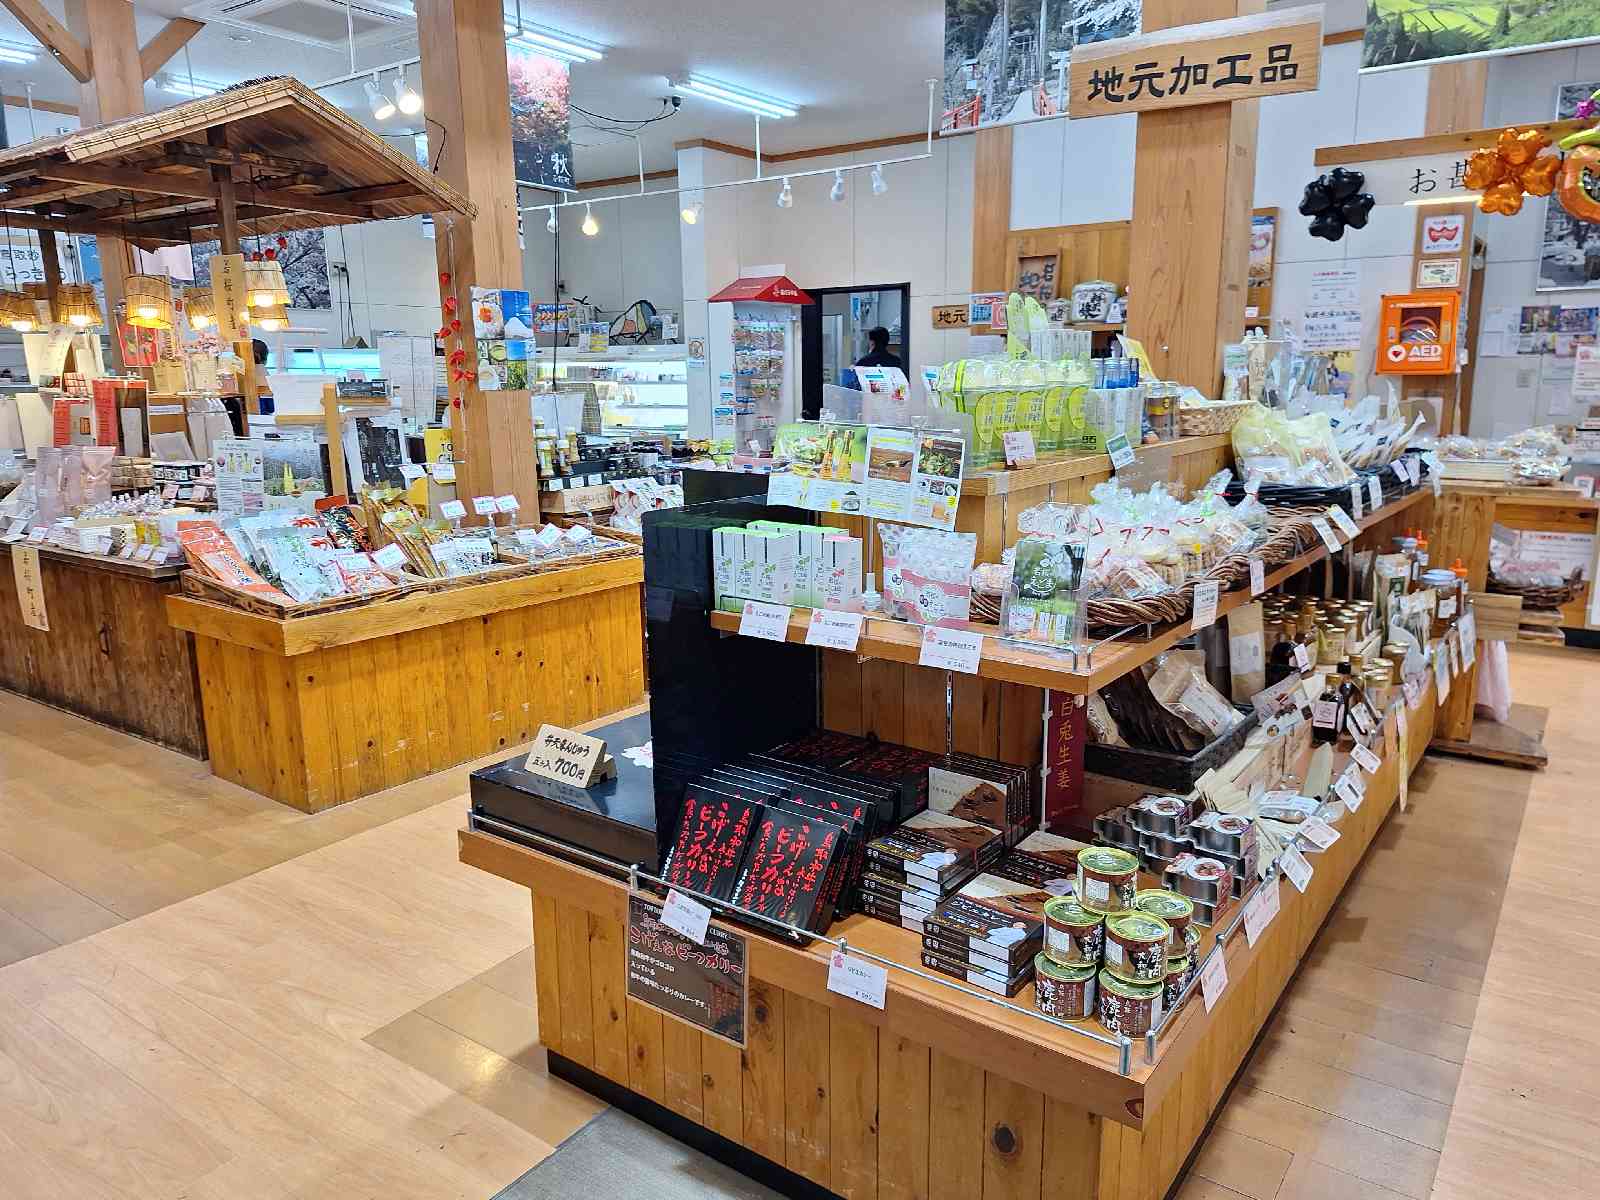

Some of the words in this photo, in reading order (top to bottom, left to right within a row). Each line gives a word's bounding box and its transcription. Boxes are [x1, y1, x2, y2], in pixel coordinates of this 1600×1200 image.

[1088, 43, 1299, 104] 地元加工品
[550, 151, 572, 178] 秋
[937, 308, 967, 325] 地元
[1408, 344, 1443, 357] AED
